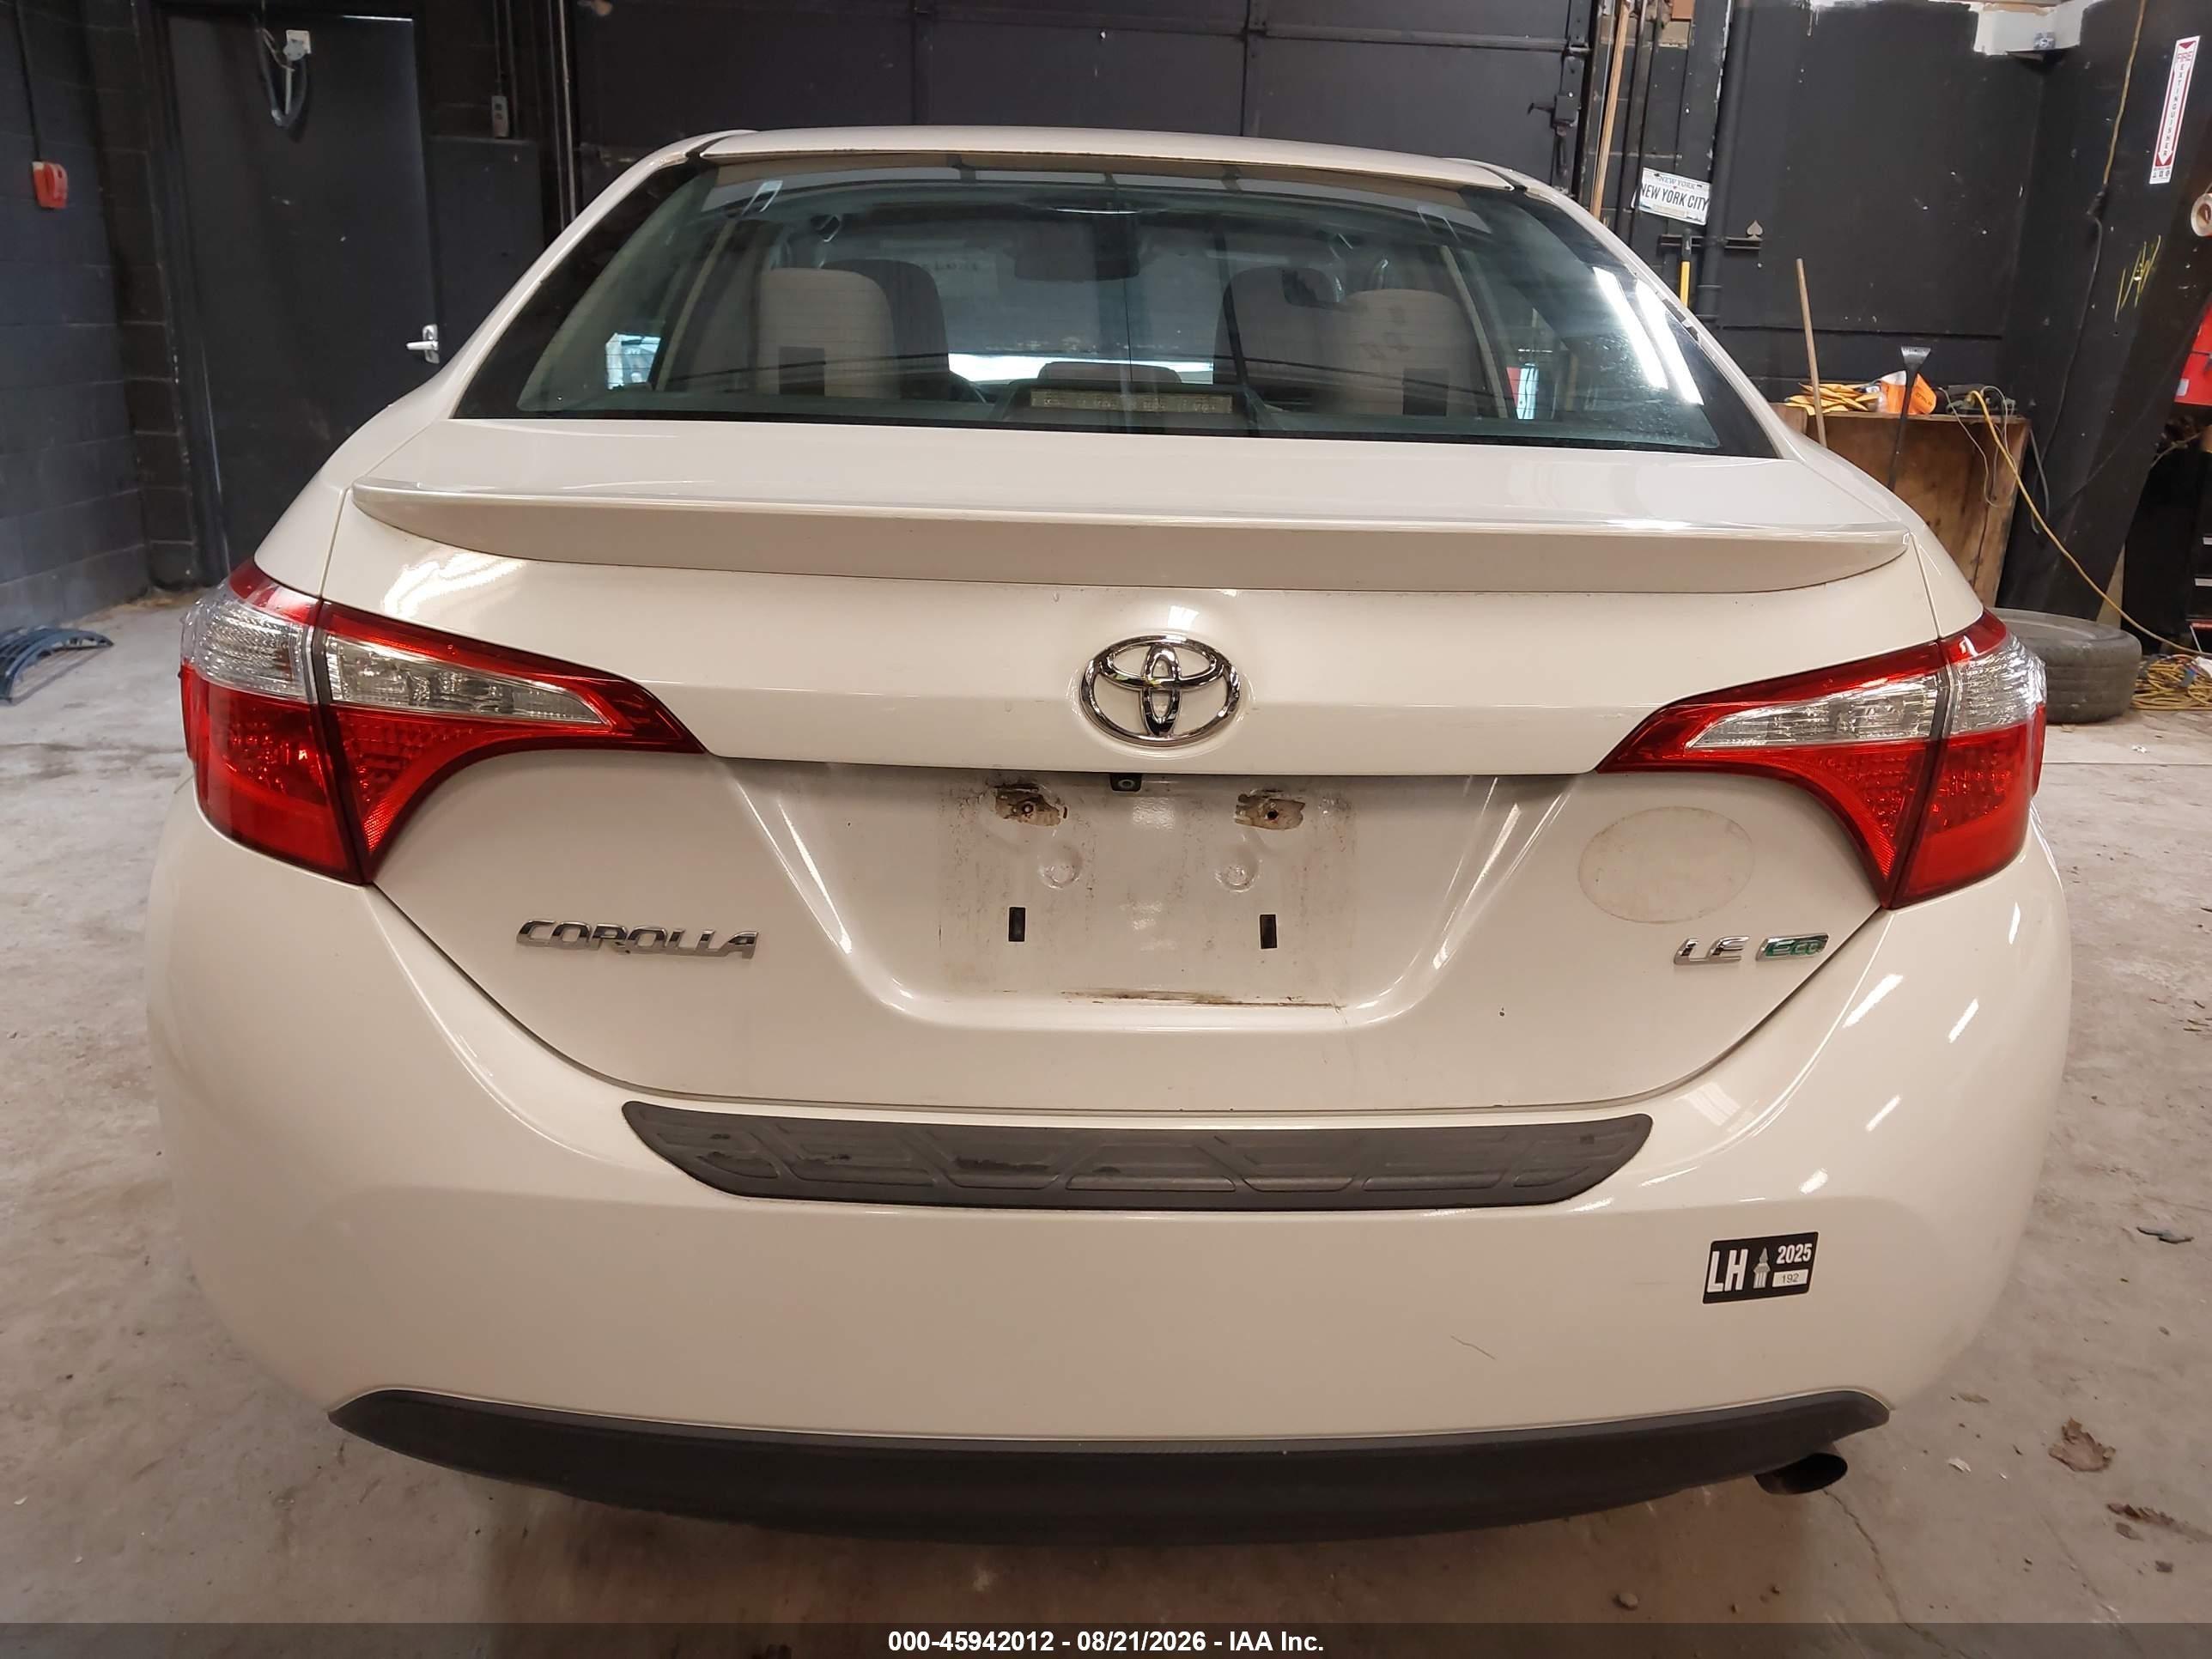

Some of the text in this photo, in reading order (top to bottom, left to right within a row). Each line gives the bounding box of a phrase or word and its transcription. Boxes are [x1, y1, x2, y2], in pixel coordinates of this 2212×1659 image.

[1658, 176, 1697, 189] NEW YORK
[1641, 184, 1710, 211] NEW YORK CITY
[516, 919, 760, 959] COROLLA
[1674, 936, 1751, 965] LE
[1706, 1243, 1813, 1292] LH 2025
[1781, 1273, 1800, 1284] 192
